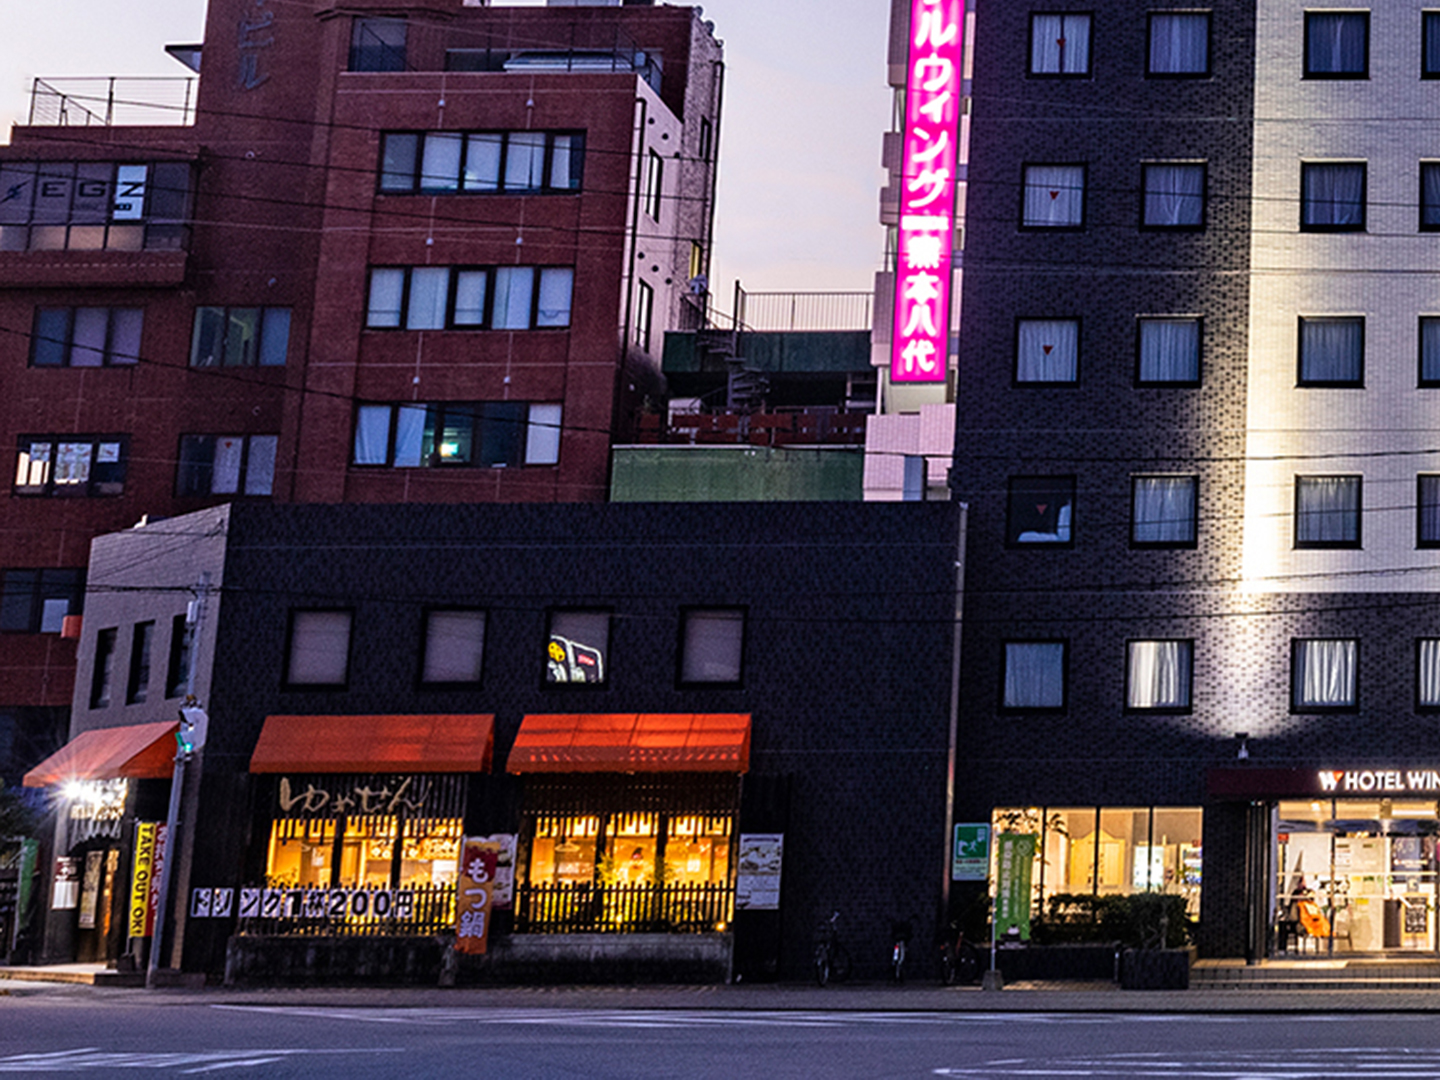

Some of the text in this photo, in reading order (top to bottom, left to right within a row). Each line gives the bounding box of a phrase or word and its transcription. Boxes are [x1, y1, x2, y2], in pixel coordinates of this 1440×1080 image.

[1344, 771, 1405, 791] HOTEL
[131, 825, 154, 935] TAKE OUT OK!
[459, 858, 489, 939] もつ鍋
